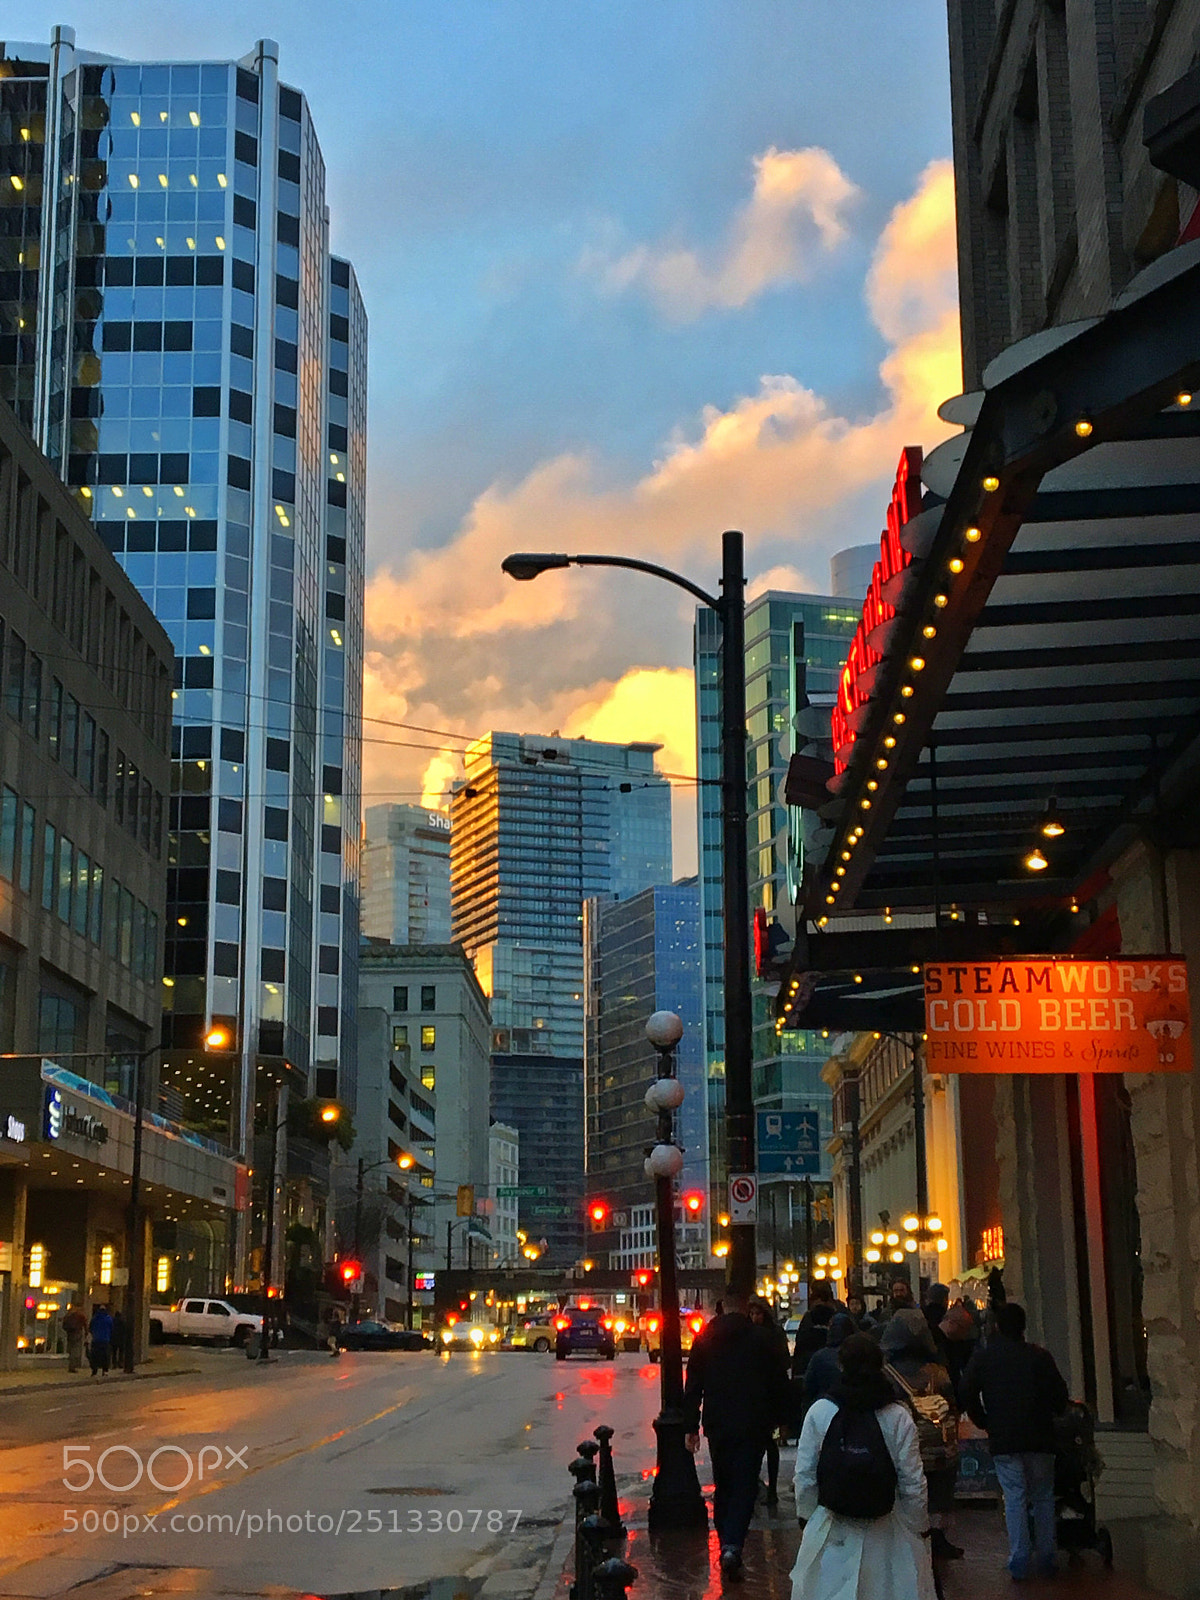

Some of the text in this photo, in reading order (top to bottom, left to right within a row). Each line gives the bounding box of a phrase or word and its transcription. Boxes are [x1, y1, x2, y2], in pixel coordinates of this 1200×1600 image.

[925, 964, 1187, 994] STEAMWORKS
[929, 997, 1138, 1032] COLD BEER
[930, 1041, 978, 1059] FINE
[985, 1041, 1056, 1059] WINES
[1062, 1043, 1074, 1058] &
